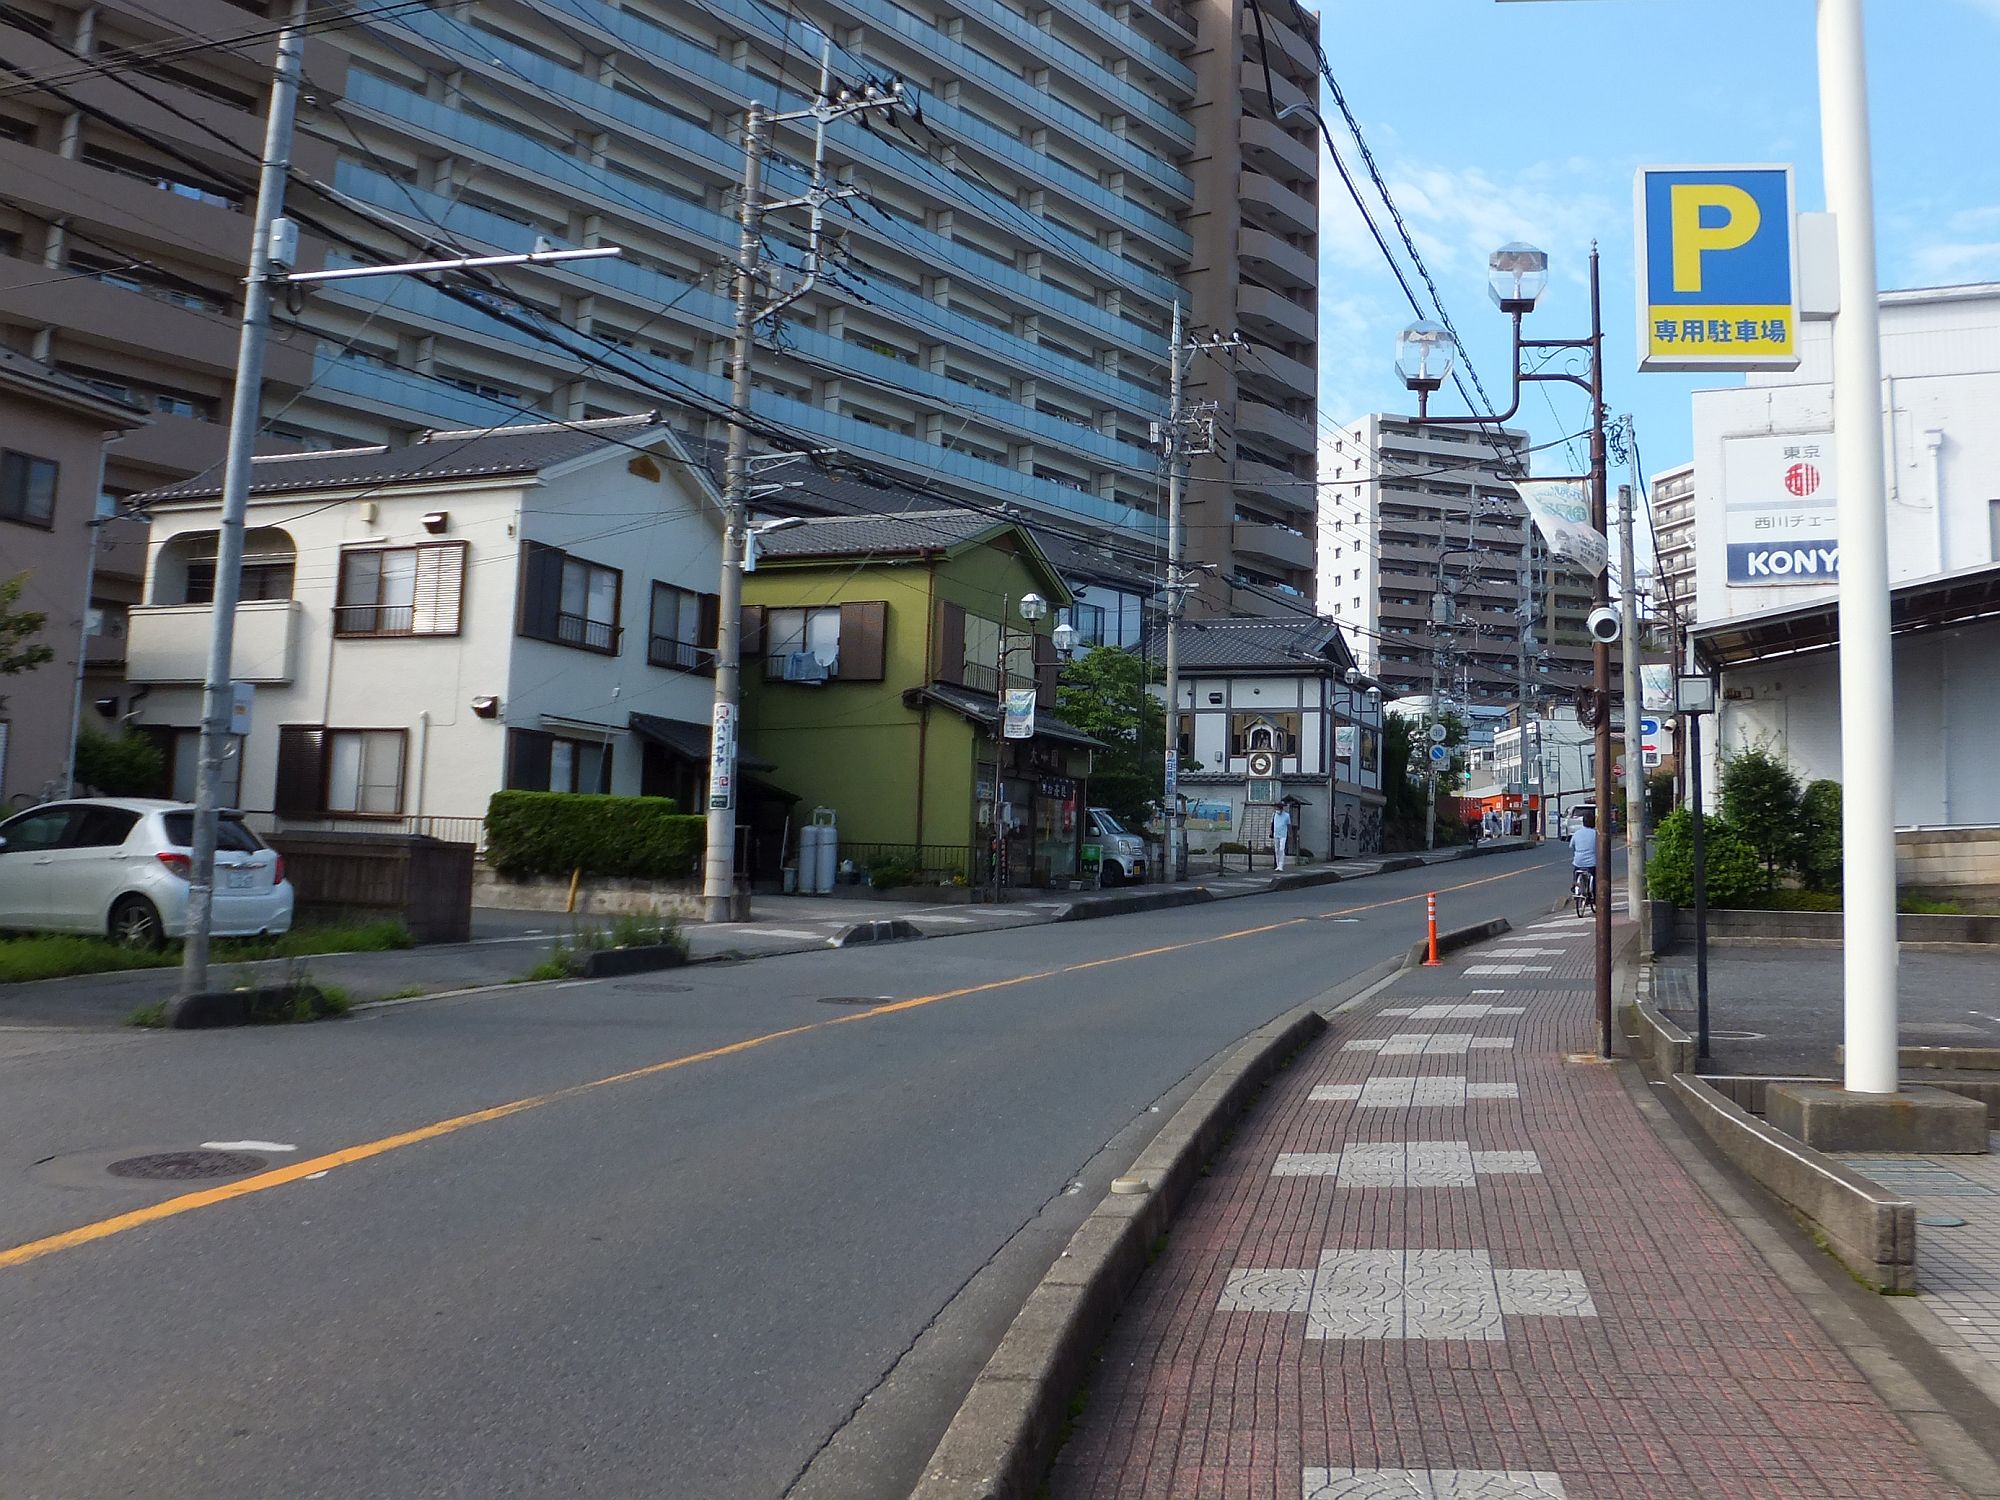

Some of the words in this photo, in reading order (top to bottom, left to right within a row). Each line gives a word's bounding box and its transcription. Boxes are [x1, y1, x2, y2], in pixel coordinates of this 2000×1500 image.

[1671, 184, 1762, 292] P
[1654, 319, 1786, 343] 専用駐車場
[1783, 445, 1821, 460] 東京
[1748, 547, 1840, 576] KONY
